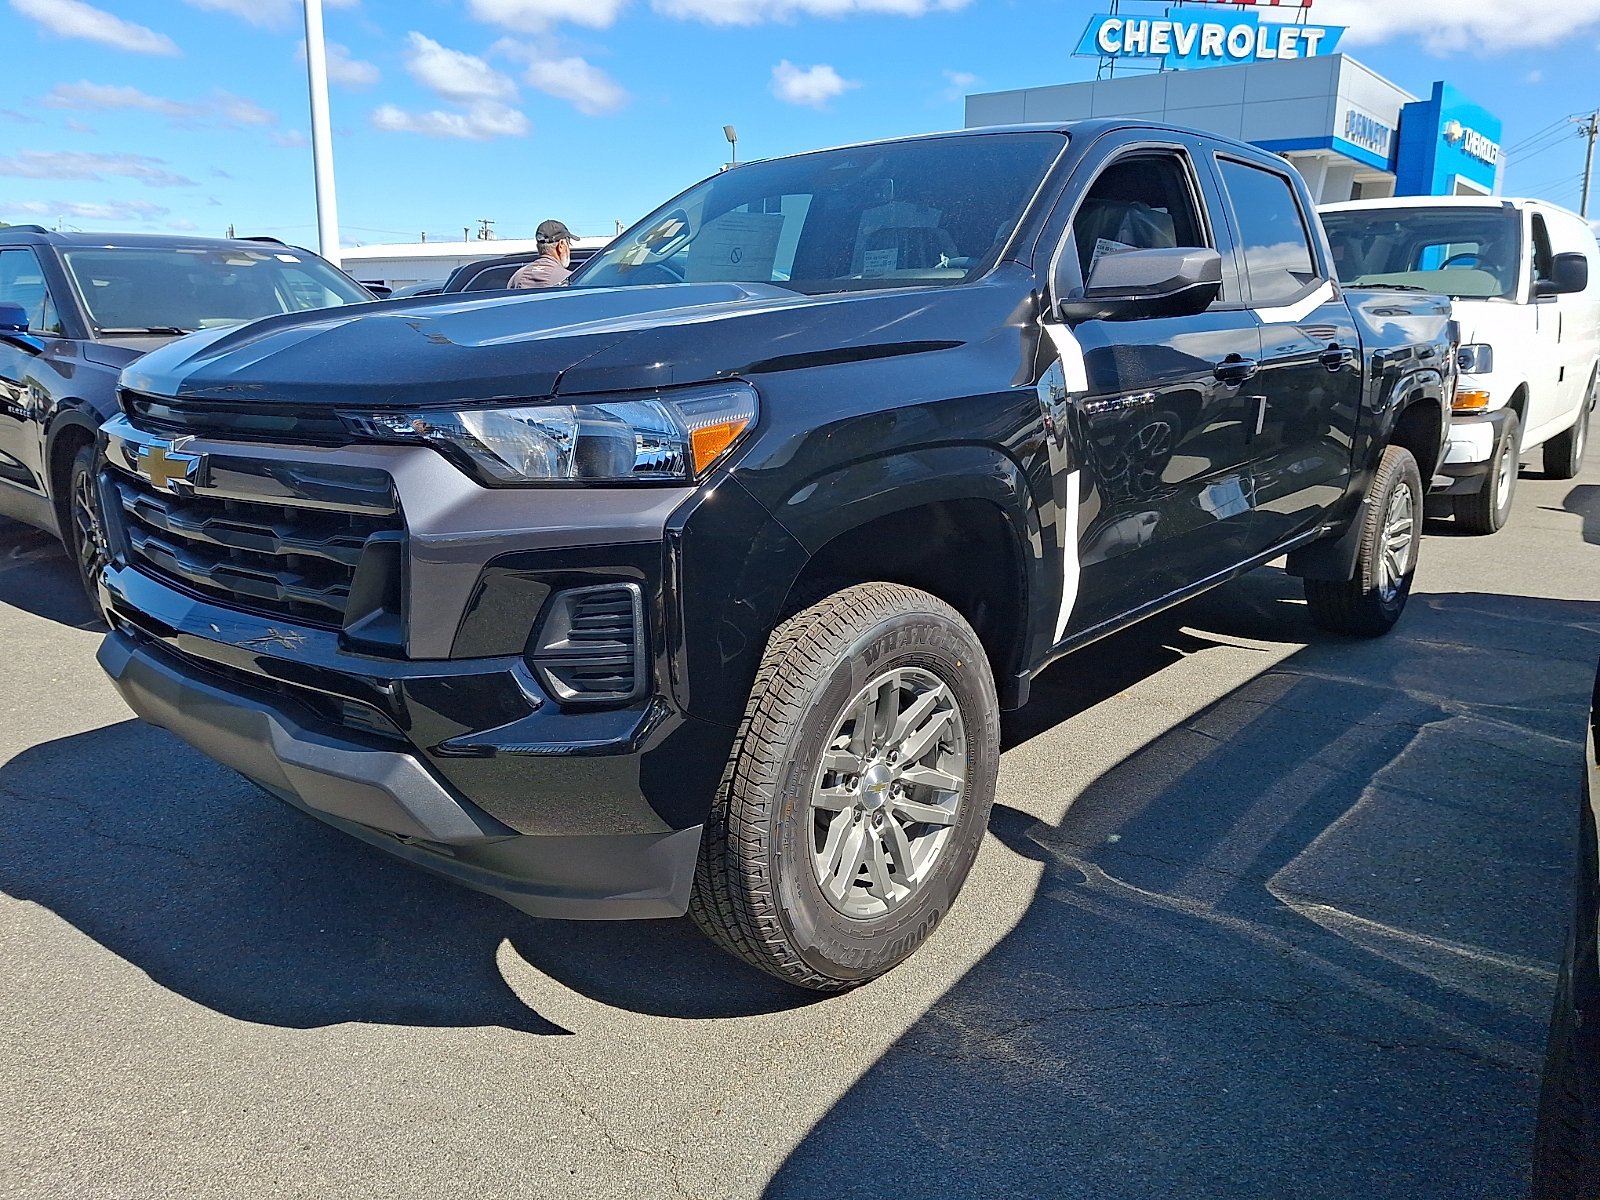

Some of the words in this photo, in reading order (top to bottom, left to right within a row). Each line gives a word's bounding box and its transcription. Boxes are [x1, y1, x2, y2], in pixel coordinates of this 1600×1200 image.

[1097, 18, 1324, 59] CHEVROLET
[1463, 126, 1500, 166] CHEVROLET
[861, 624, 975, 667] WRANGLER
